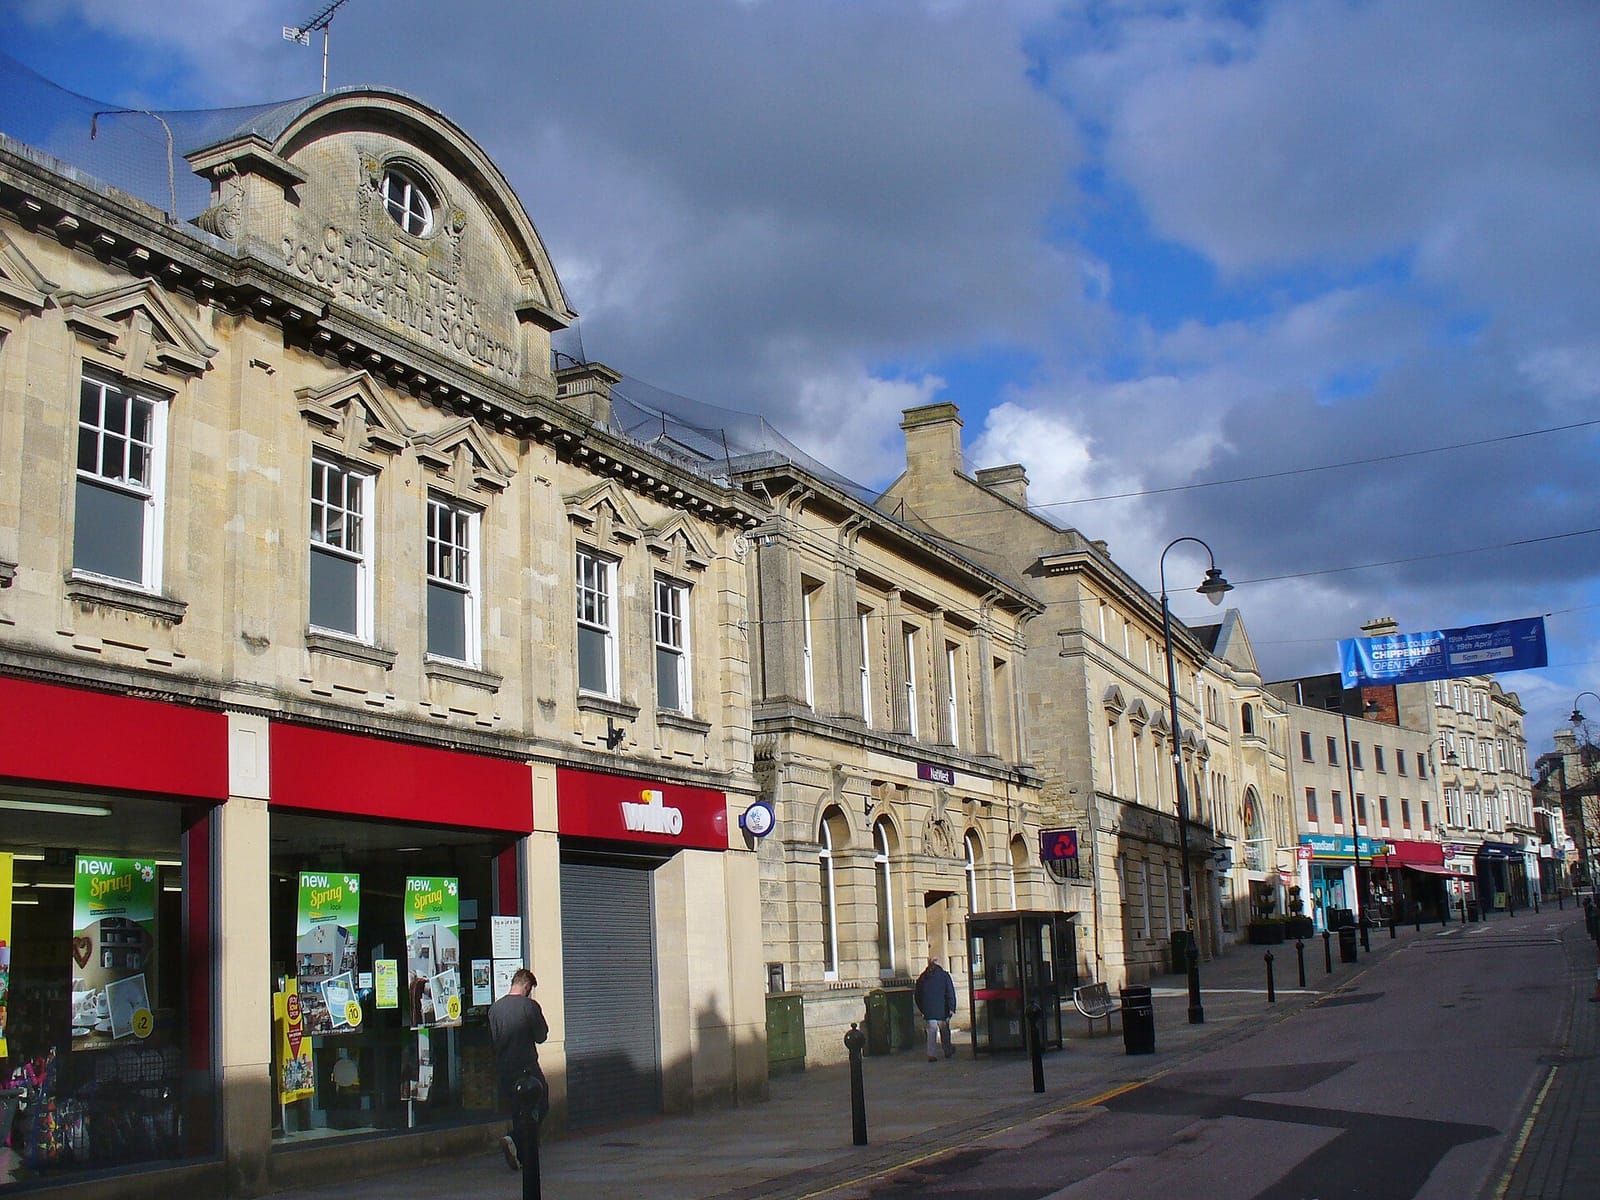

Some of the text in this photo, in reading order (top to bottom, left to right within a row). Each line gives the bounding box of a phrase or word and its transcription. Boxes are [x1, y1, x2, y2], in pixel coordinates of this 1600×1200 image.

[321, 225, 479, 330] CHIPPENHAM
[1371, 637, 1441, 650] WILTSHIRE COLLEGE
[1464, 631, 1493, 643] January
[1474, 639, 1492, 649] April
[1372, 645, 1441, 659] CHIPPENHAM
[1372, 660, 1401, 671] OPEN
[1403, 656, 1442, 669] EVENTS
[930, 767, 950, 784] NatWest
[621, 789, 683, 835] wilko
[90, 874, 132, 900] Spring
[311, 886, 342, 909] Spring
[415, 889, 442, 911] Spring
